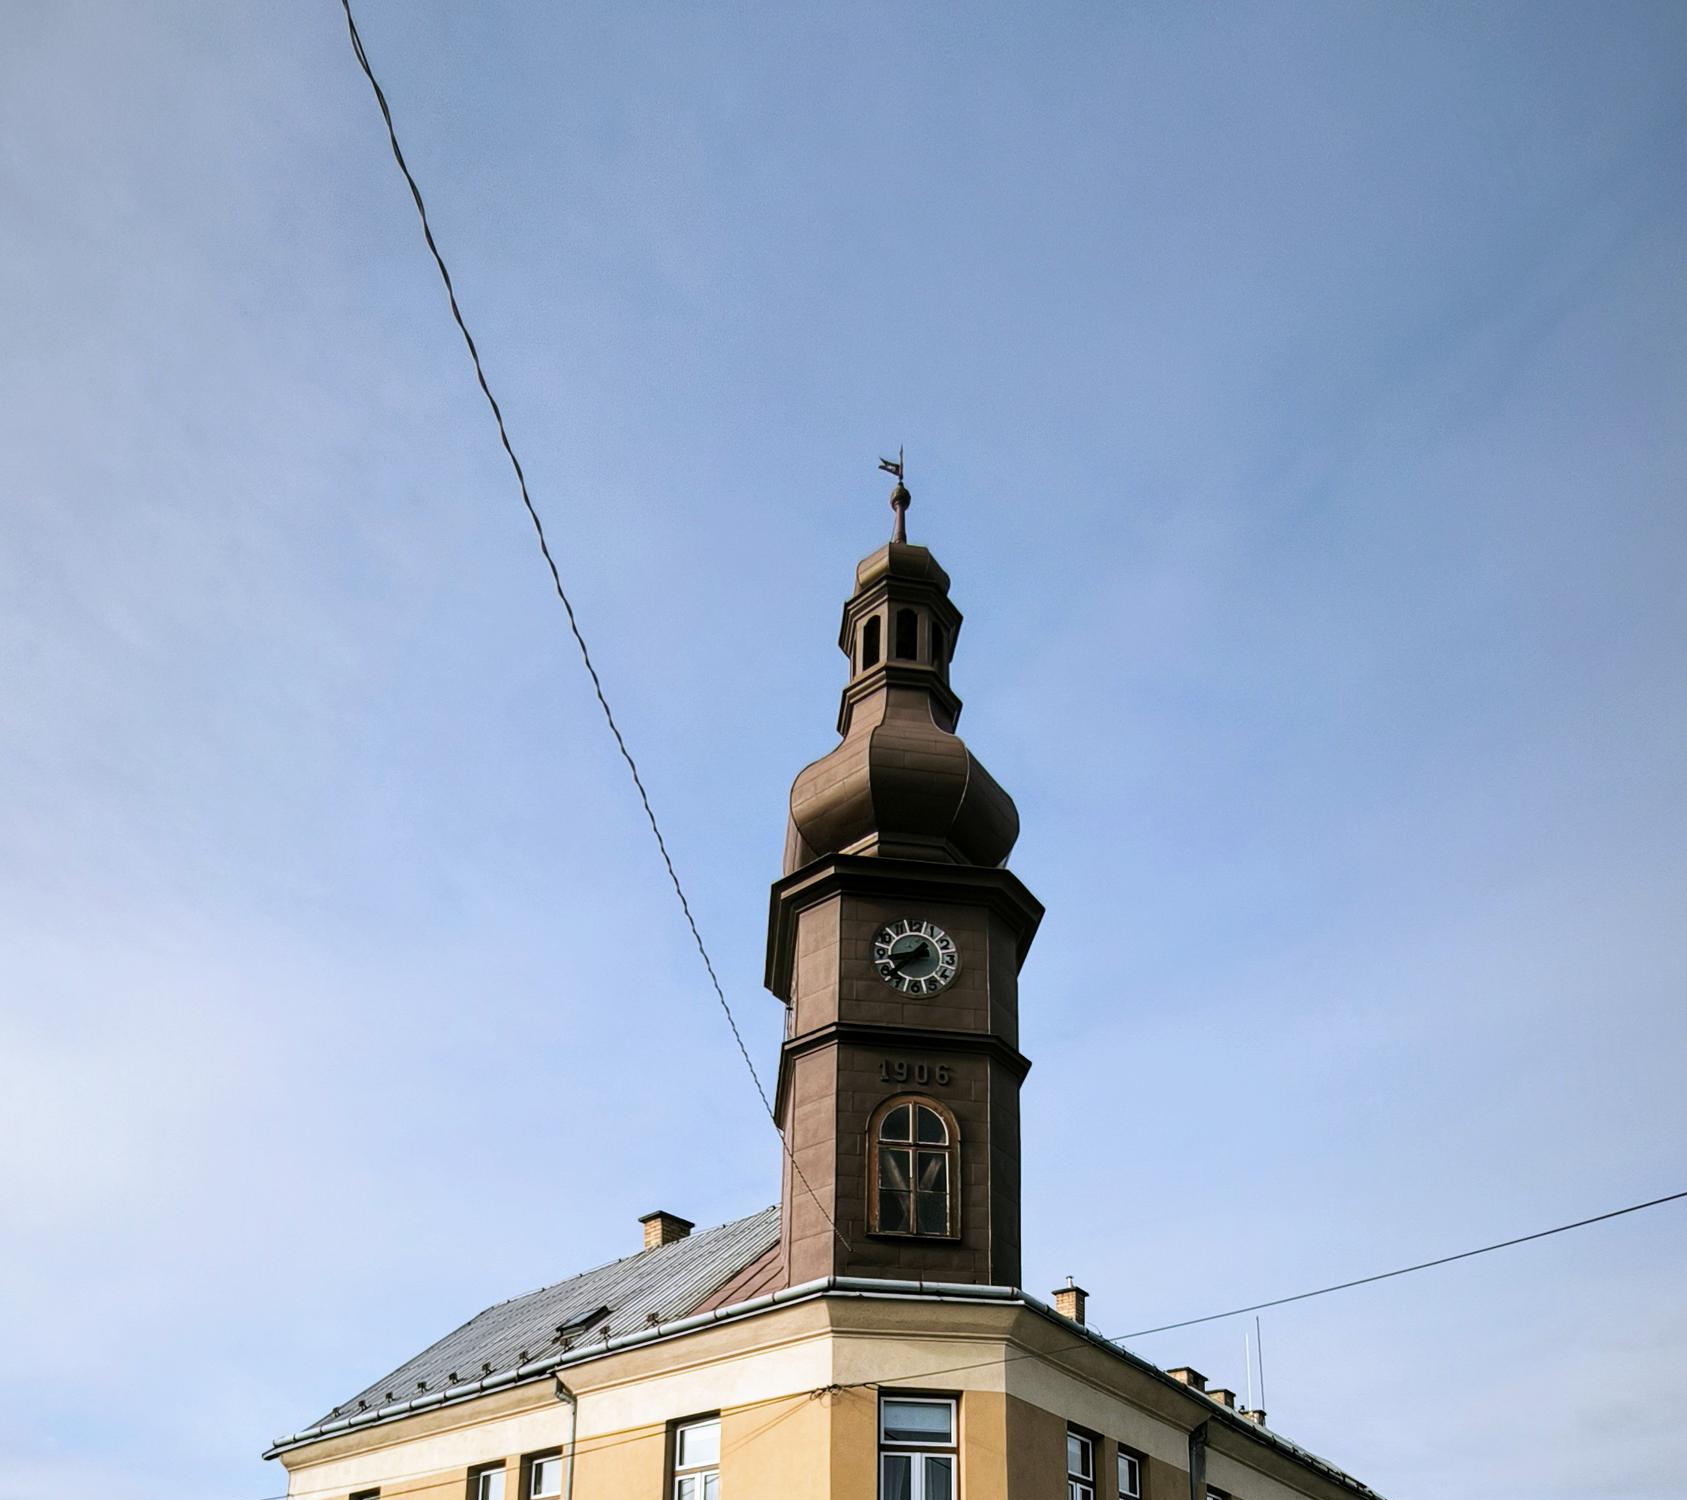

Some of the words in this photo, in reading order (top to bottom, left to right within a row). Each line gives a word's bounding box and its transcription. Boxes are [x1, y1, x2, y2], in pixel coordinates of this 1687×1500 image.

[895, 923, 904, 935] 11
[909, 921, 922, 933] 12
[929, 925, 935, 938] 1
[879, 931, 892, 944] 10
[940, 939, 950, 950] 2
[876, 948, 886, 960] 9
[946, 954, 956, 966] 3
[881, 965, 890, 976] 8
[940, 968, 950, 981] 4
[911, 981, 920, 994] 6
[928, 979, 938, 992] 5
[879, 1060, 949, 1085] 1906
